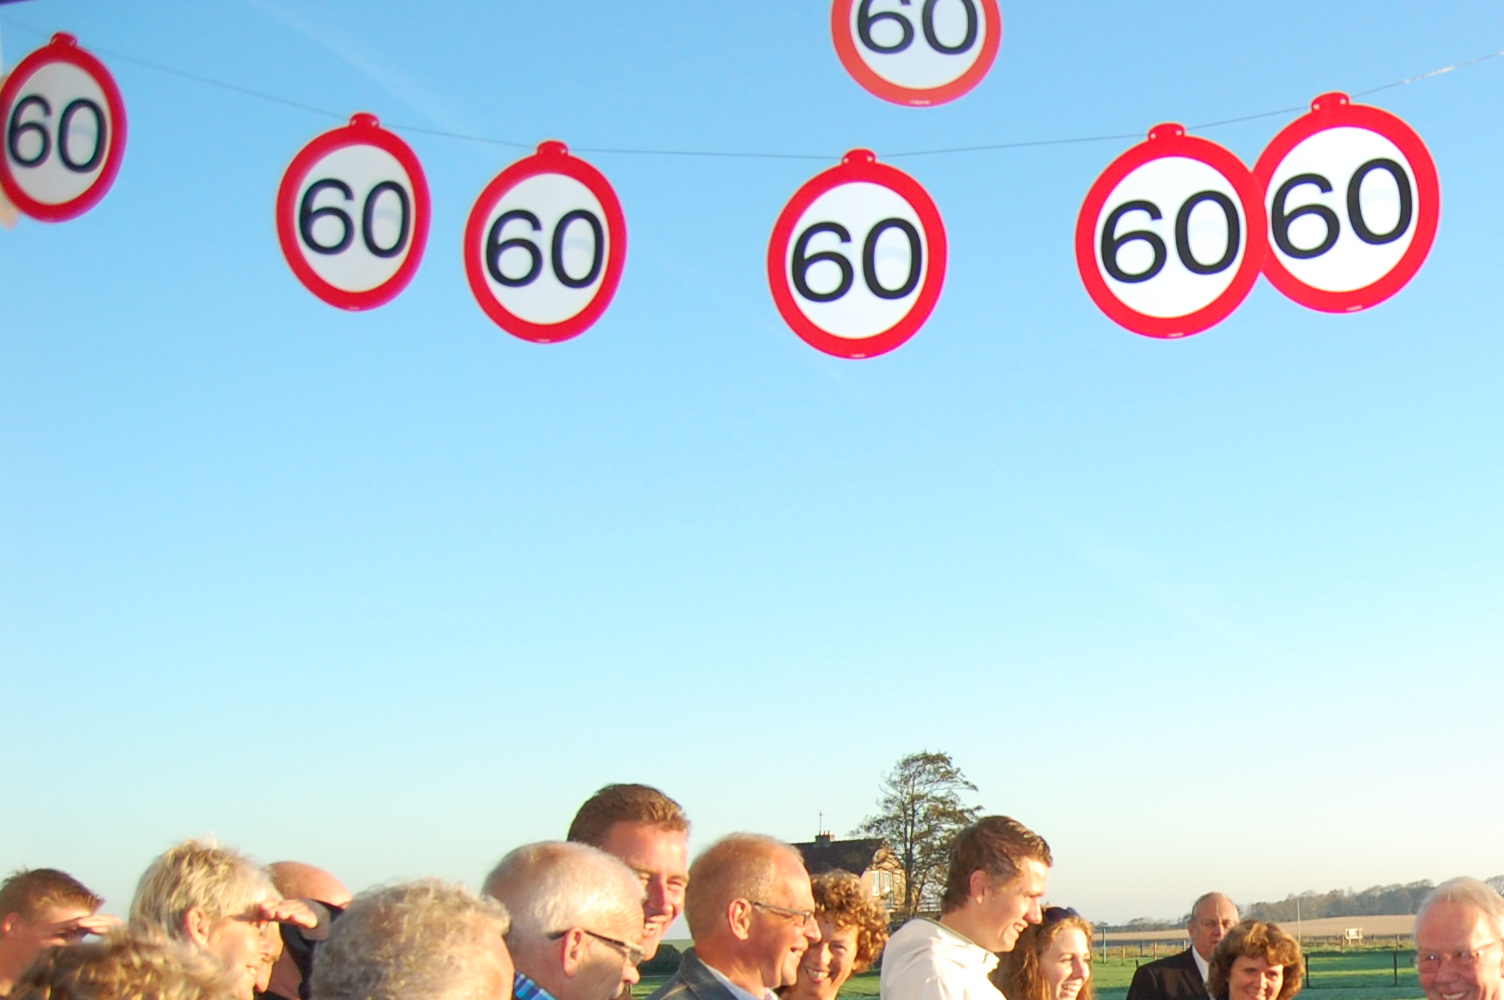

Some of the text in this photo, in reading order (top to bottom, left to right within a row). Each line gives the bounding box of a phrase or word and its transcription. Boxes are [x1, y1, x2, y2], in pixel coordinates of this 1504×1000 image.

[857, 0, 978, 54] 60
[8, 94, 108, 174] 60
[298, 178, 411, 258] 60
[485, 208, 605, 288] 60
[1100, 190, 1241, 283] 60
[1271, 157, 1413, 259] 60
[791, 217, 923, 303] 60
